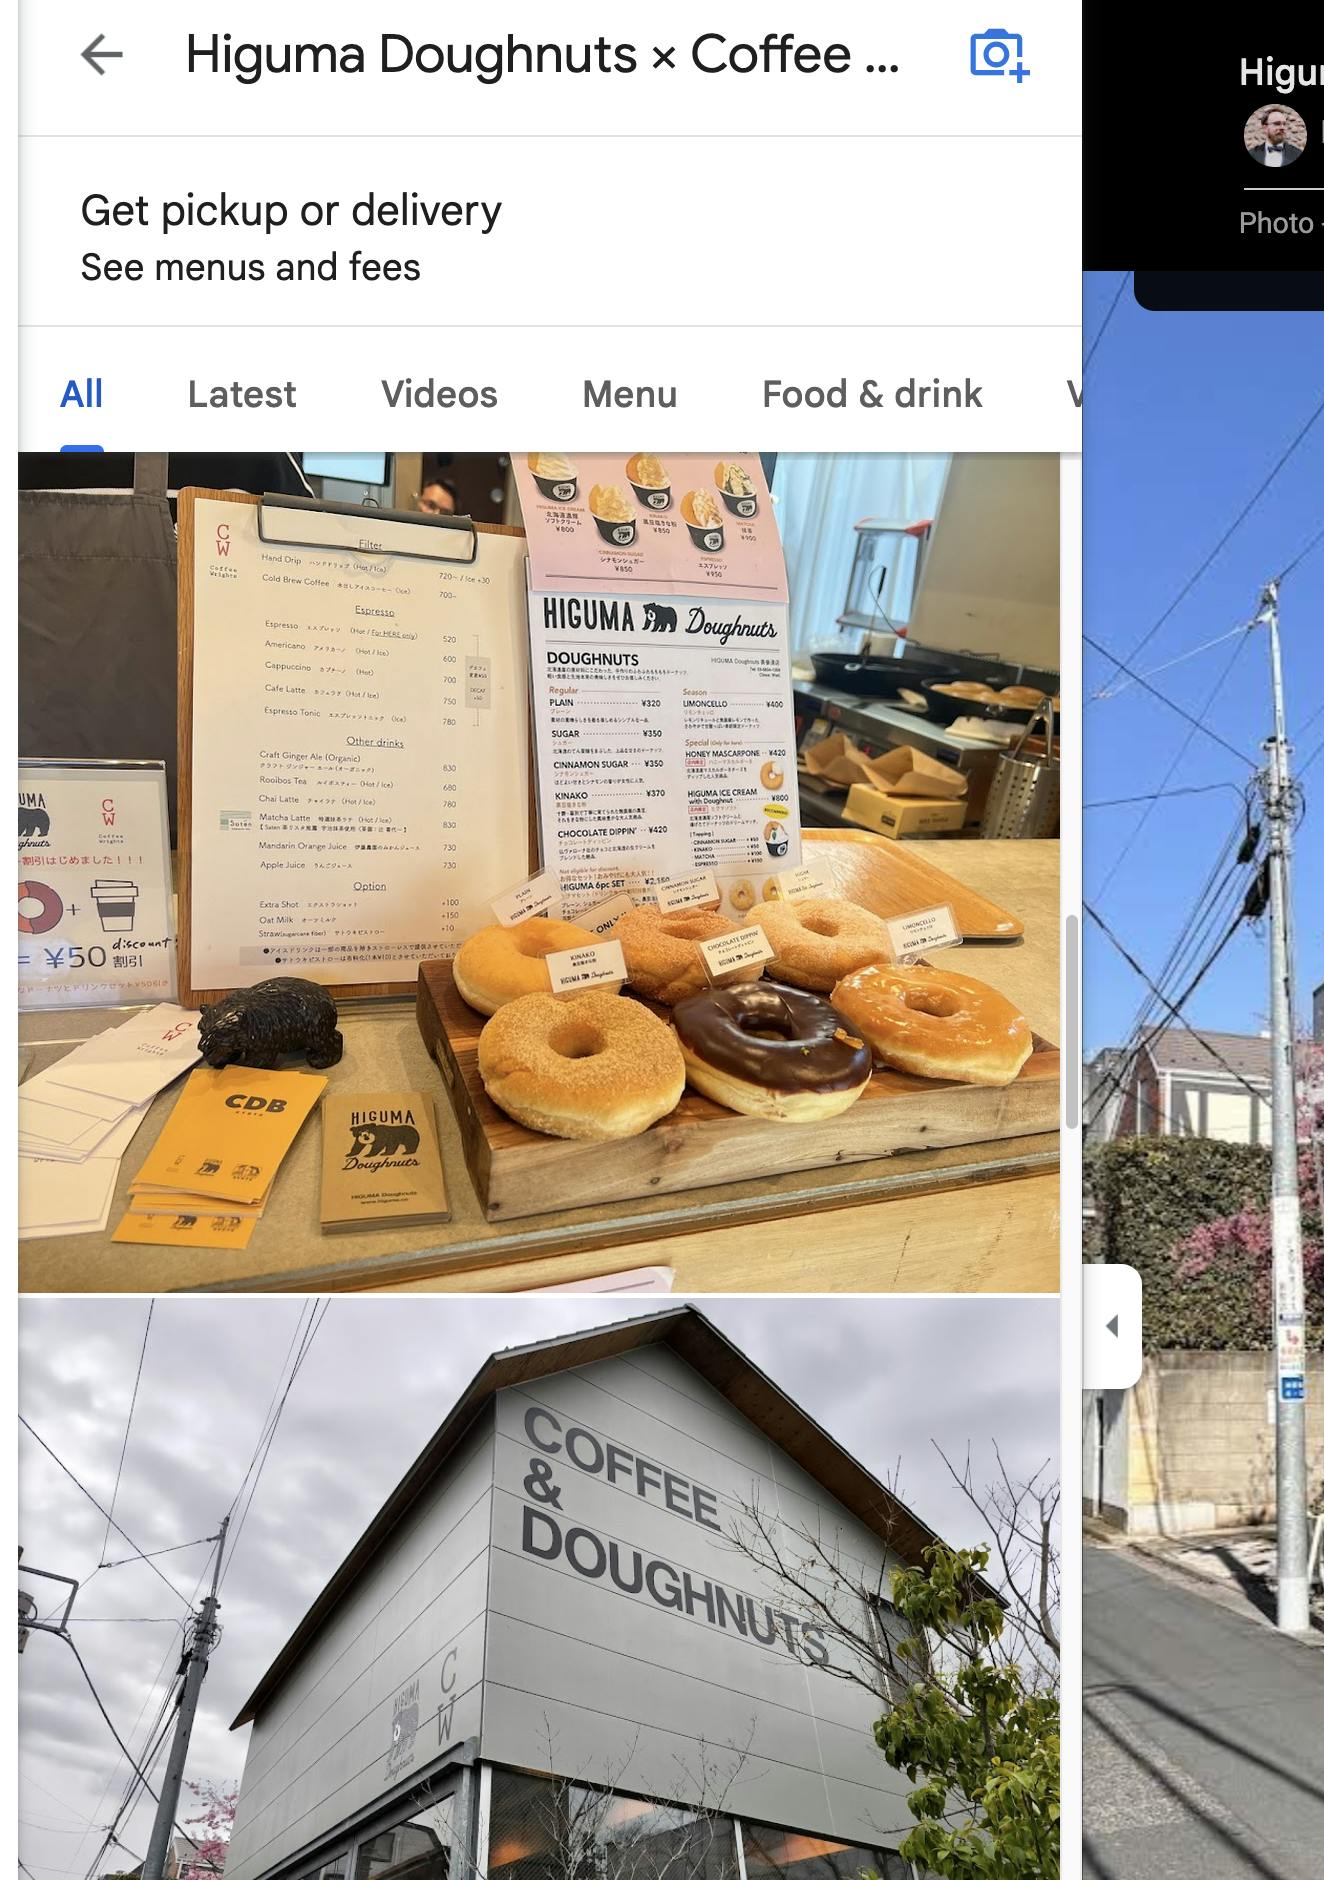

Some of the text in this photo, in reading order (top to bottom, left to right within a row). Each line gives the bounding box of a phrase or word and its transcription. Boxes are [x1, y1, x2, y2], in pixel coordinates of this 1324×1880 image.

[189, 33, 364, 84] Higuma
[382, 34, 637, 84] Doughnuts
[692, 33, 851, 73] Coffee
[82, 192, 502, 234] Get pickup or delivery
[1241, 211, 1313, 234] Photo
[82, 250, 420, 281] See menus and fees
[60, 378, 101, 407] All
[190, 380, 296, 408] Latest
[381, 378, 497, 408] Videos
[584, 380, 676, 408] Menu
[764, 378, 983, 408] Food & drink
[217, 524, 230, 540] C
[216, 540, 231, 557] W
[359, 539, 383, 550] Filter
[262, 554, 302, 565] Hand Drip
[262, 573, 329, 587] Cold Brew Coffee
[355, 605, 395, 617] Espresso
[265, 620, 299, 630] Espresso
[544, 597, 777, 645] HIGUMA Doughnuts
[265, 640, 306, 650] Americano
[547, 652, 639, 666] DOUGHNUTS
[265, 661, 312, 672] Cappuccino
[443, 676, 457, 684] 700
[265, 684, 283, 692] Cafe
[286, 685, 306, 694] Latte
[549, 686, 578, 696] Regular
[683, 700, 728, 708] LIMONCELLO
[264, 706, 457, 726] Espresso Tonic 780
[552, 730, 579, 738] SUGAR
[346, 736, 405, 749] Other drinks
[685, 739, 709, 747] Special
[260, 751, 280, 759] Craft
[282, 751, 308, 761] Ginger
[325, 753, 361, 763] (Organic)
[686, 750, 711, 758] HONEY
[712, 749, 760, 757] MASCARPONE
[553, 761, 600, 769] CINNAMON
[644, 760, 664, 768] ¥350
[259, 776, 457, 792] Rooibos Tea 680
[555, 792, 588, 800] KINAKO
[688, 790, 717, 798] HIGUMA
[720, 789, 730, 797] ICE
[704, 797, 733, 805] Doughnut
[771, 794, 789, 802] ¥800
[102, 799, 114, 812] C
[259, 794, 457, 808] Chai Latte 780
[102, 813, 115, 826] W
[260, 814, 288, 822] Matcha
[291, 814, 310, 822] Latte
[558, 828, 608, 838] CHOCOLATE
[259, 842, 295, 850] Mandarin
[298, 842, 326, 852] Orange
[328, 842, 347, 850] Juice
[19, 856, 143, 866] 割引はじめました！！！
[260, 861, 283, 870] Apple
[286, 861, 306, 869] Juice
[353, 881, 387, 892] Option
[561, 880, 625, 891] HIGUMA 6pc SET
[260, 916, 274, 924] Oat
[276, 916, 294, 924] Milk
[112, 938, 172, 950] discount
[708, 935, 739, 951] CHOCOLATE
[44, 946, 143, 968] ¥50 割引
[571, 951, 595, 960] KINAKO
[175, 1022, 192, 1032] C
[162, 1030, 182, 1041] W
[225, 1094, 287, 1113] CDB
[352, 1110, 415, 1125] HIGUMA
[342, 1157, 421, 1173] Doughnuts
[525, 1407, 721, 1532] COFFEE
[523, 1457, 563, 1511] &
[522, 1505, 829, 1665] DOUGHNUTS
[441, 1646, 457, 1693] C
[438, 1694, 456, 1746] W
